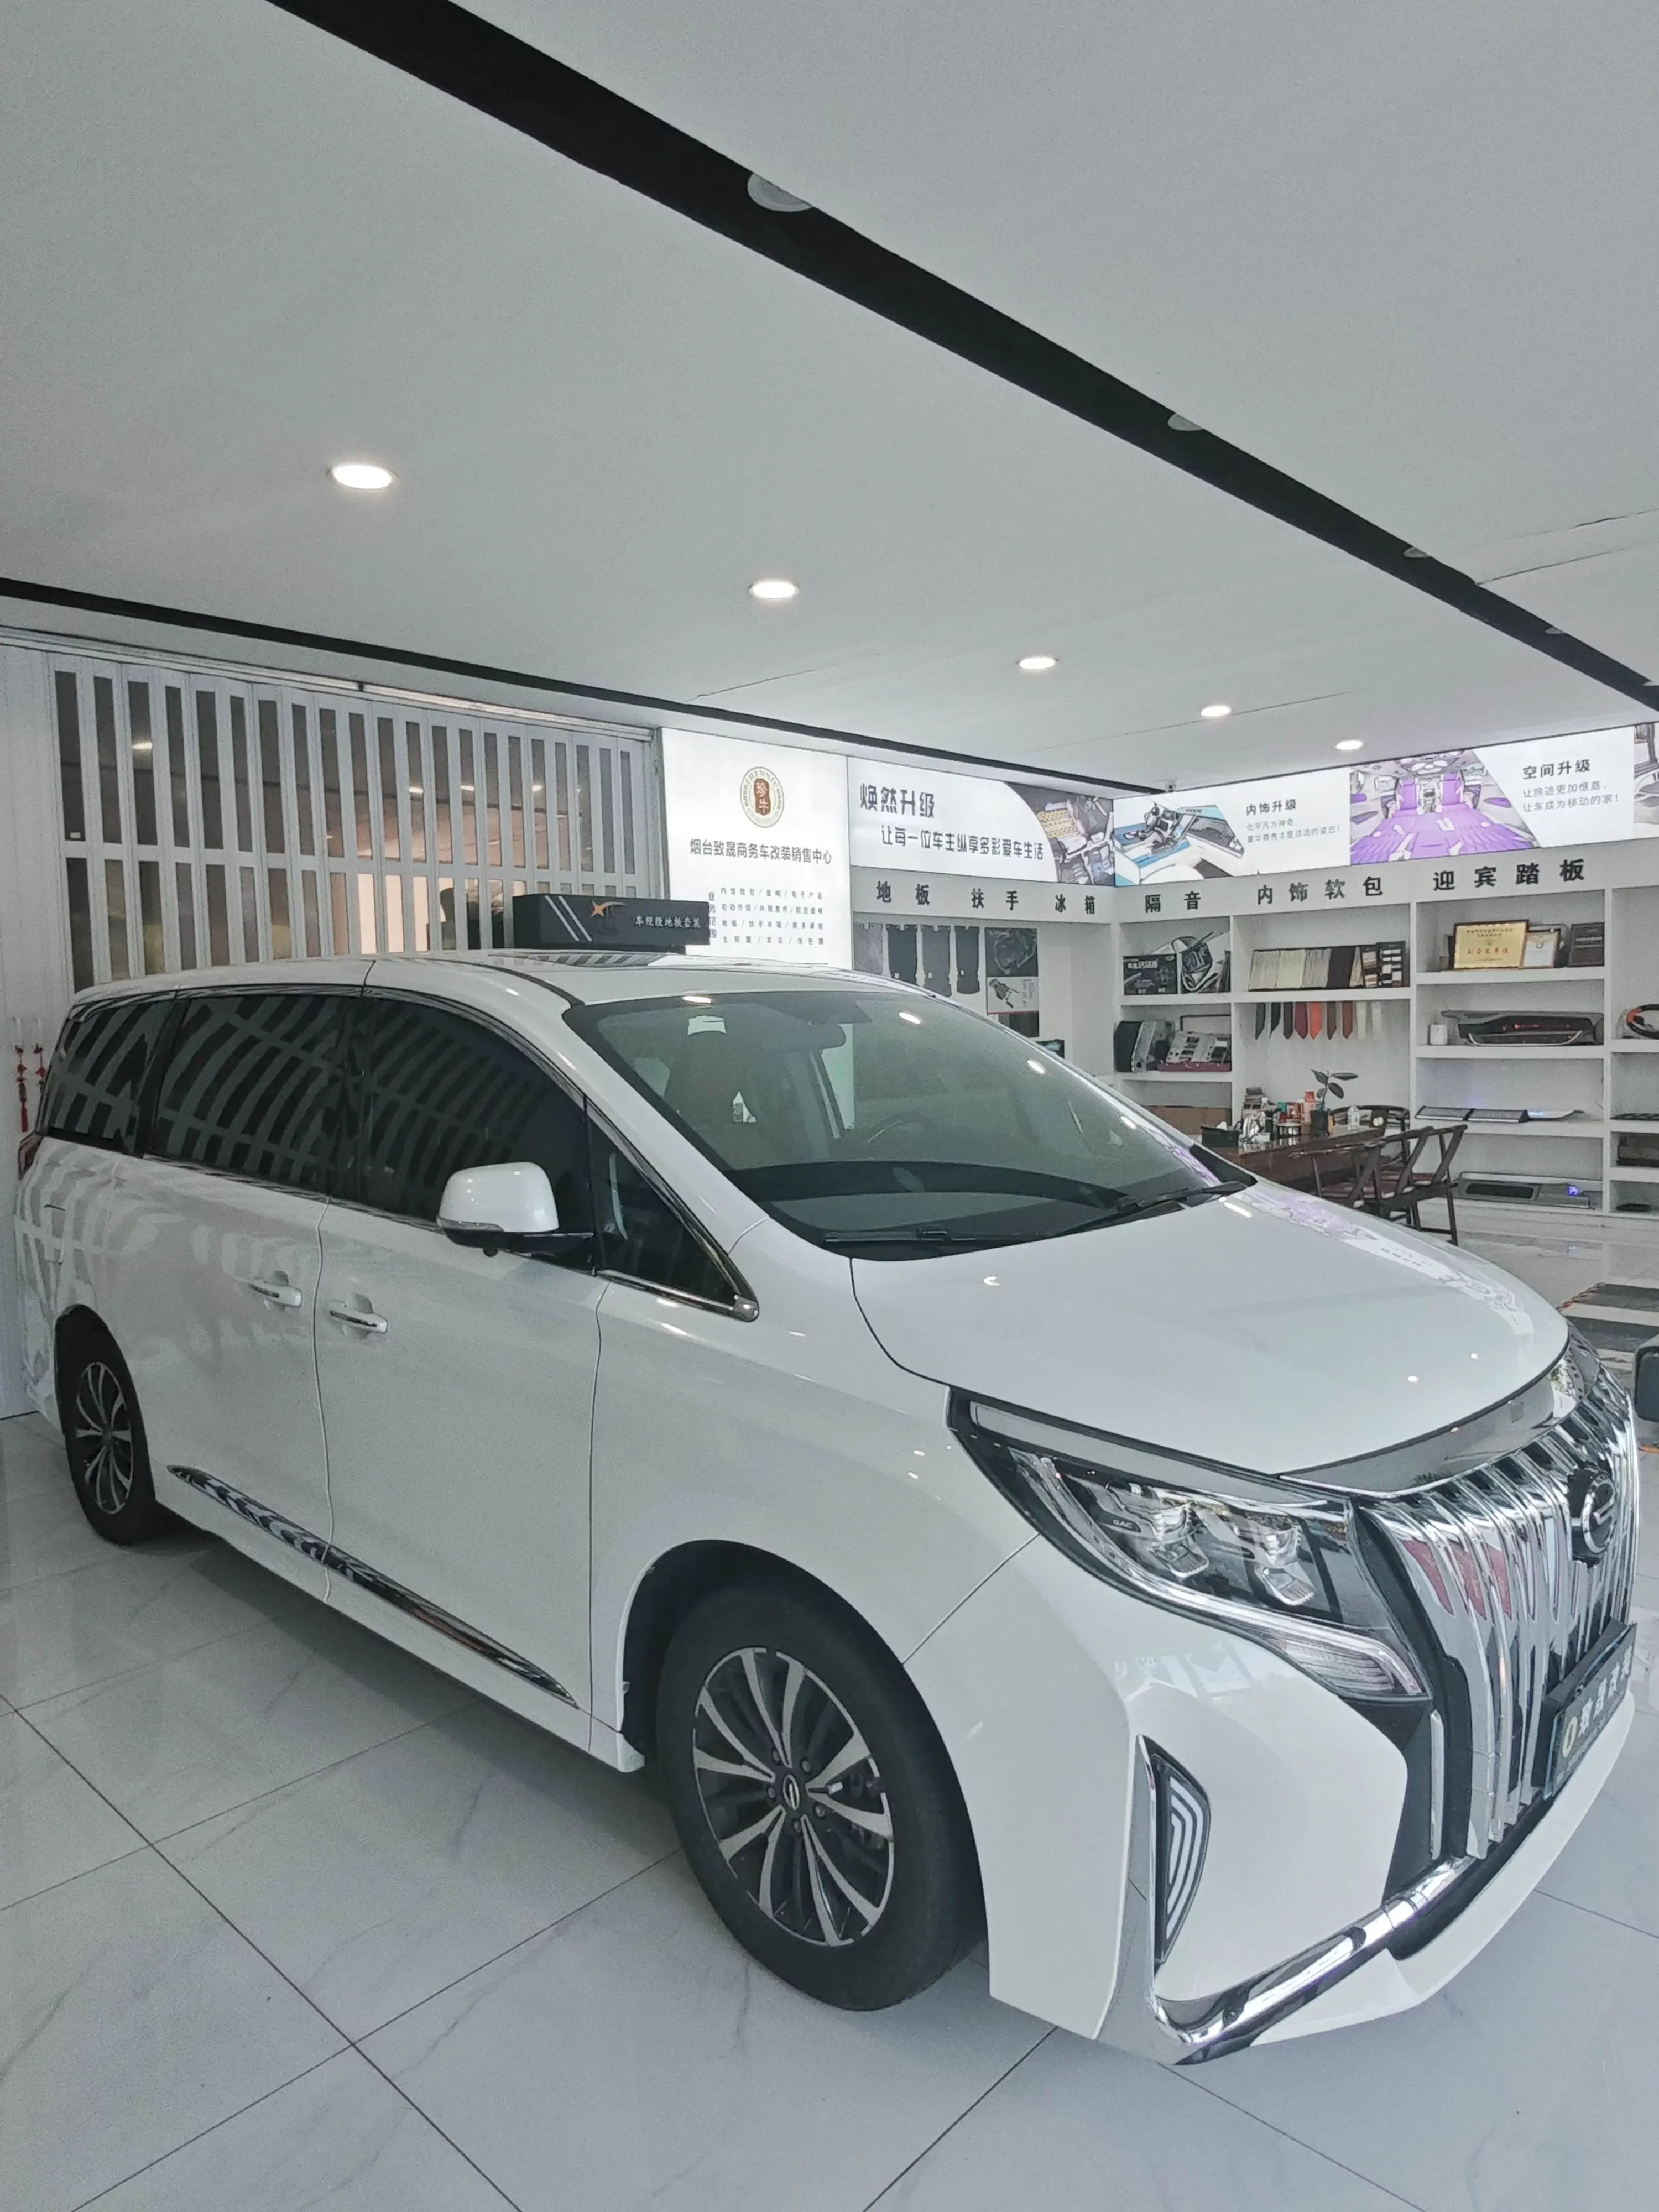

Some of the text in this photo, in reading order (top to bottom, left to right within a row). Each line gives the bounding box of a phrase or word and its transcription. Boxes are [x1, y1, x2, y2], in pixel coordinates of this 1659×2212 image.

[1522, 759, 1590, 780] 空间升级
[860, 782, 936, 820] 焕然升级
[1246, 799, 1297, 816] 内饰升级
[690, 838, 832, 864] 烟台致晟商务车改装销售中心
[881, 825, 1044, 860] 让每一位车主纵享多彩爱车生活
[1433, 858, 1585, 891] 迎宾踏板
[876, 880, 930, 906] 地板
[971, 888, 1019, 910] 扶手
[1145, 890, 1202, 914] 隔音
[1258, 876, 1383, 905] 内饰软包
[1055, 894, 1095, 915] 冰箱
